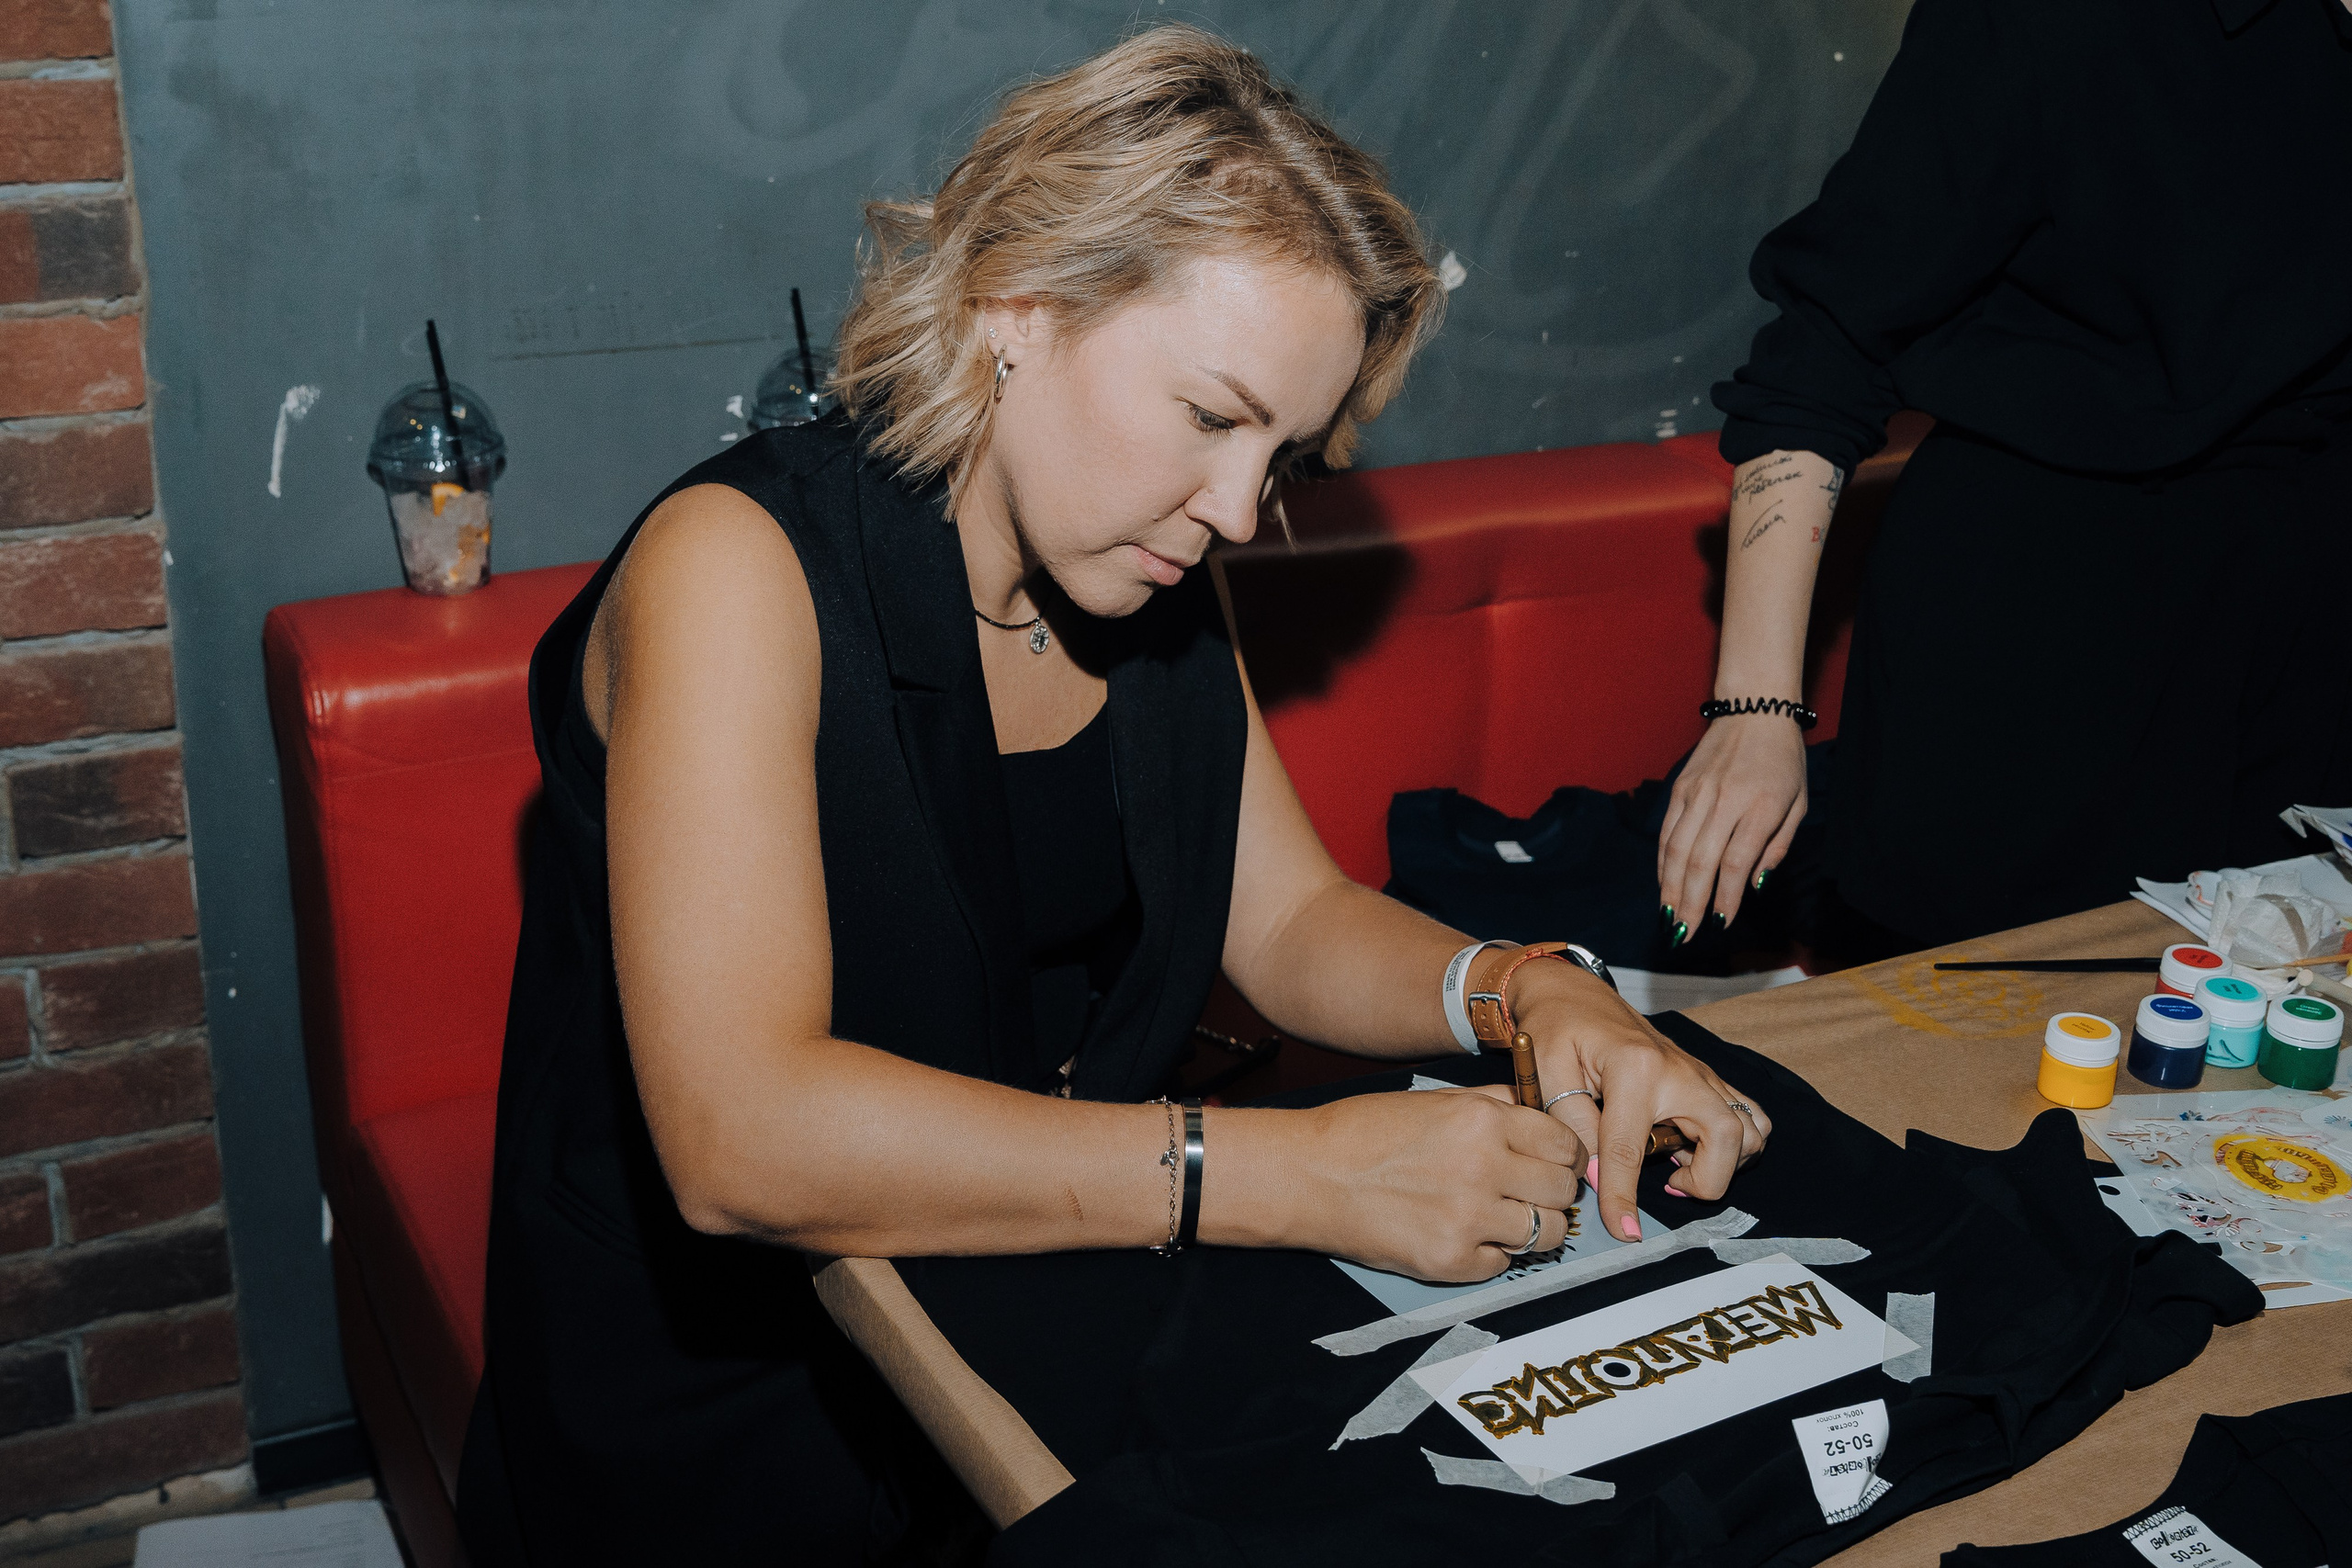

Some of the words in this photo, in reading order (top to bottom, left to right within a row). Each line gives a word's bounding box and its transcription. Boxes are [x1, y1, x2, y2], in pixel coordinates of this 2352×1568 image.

[1458, 1280, 1843, 1439] МЕГАПОЛИС
[1843, 1408, 1864, 1418] 100%
[1827, 1420, 1859, 1432] Состав:
[1824, 1433, 1873, 1457] 50-52
[2170, 1542, 2212, 1563] 50-52
